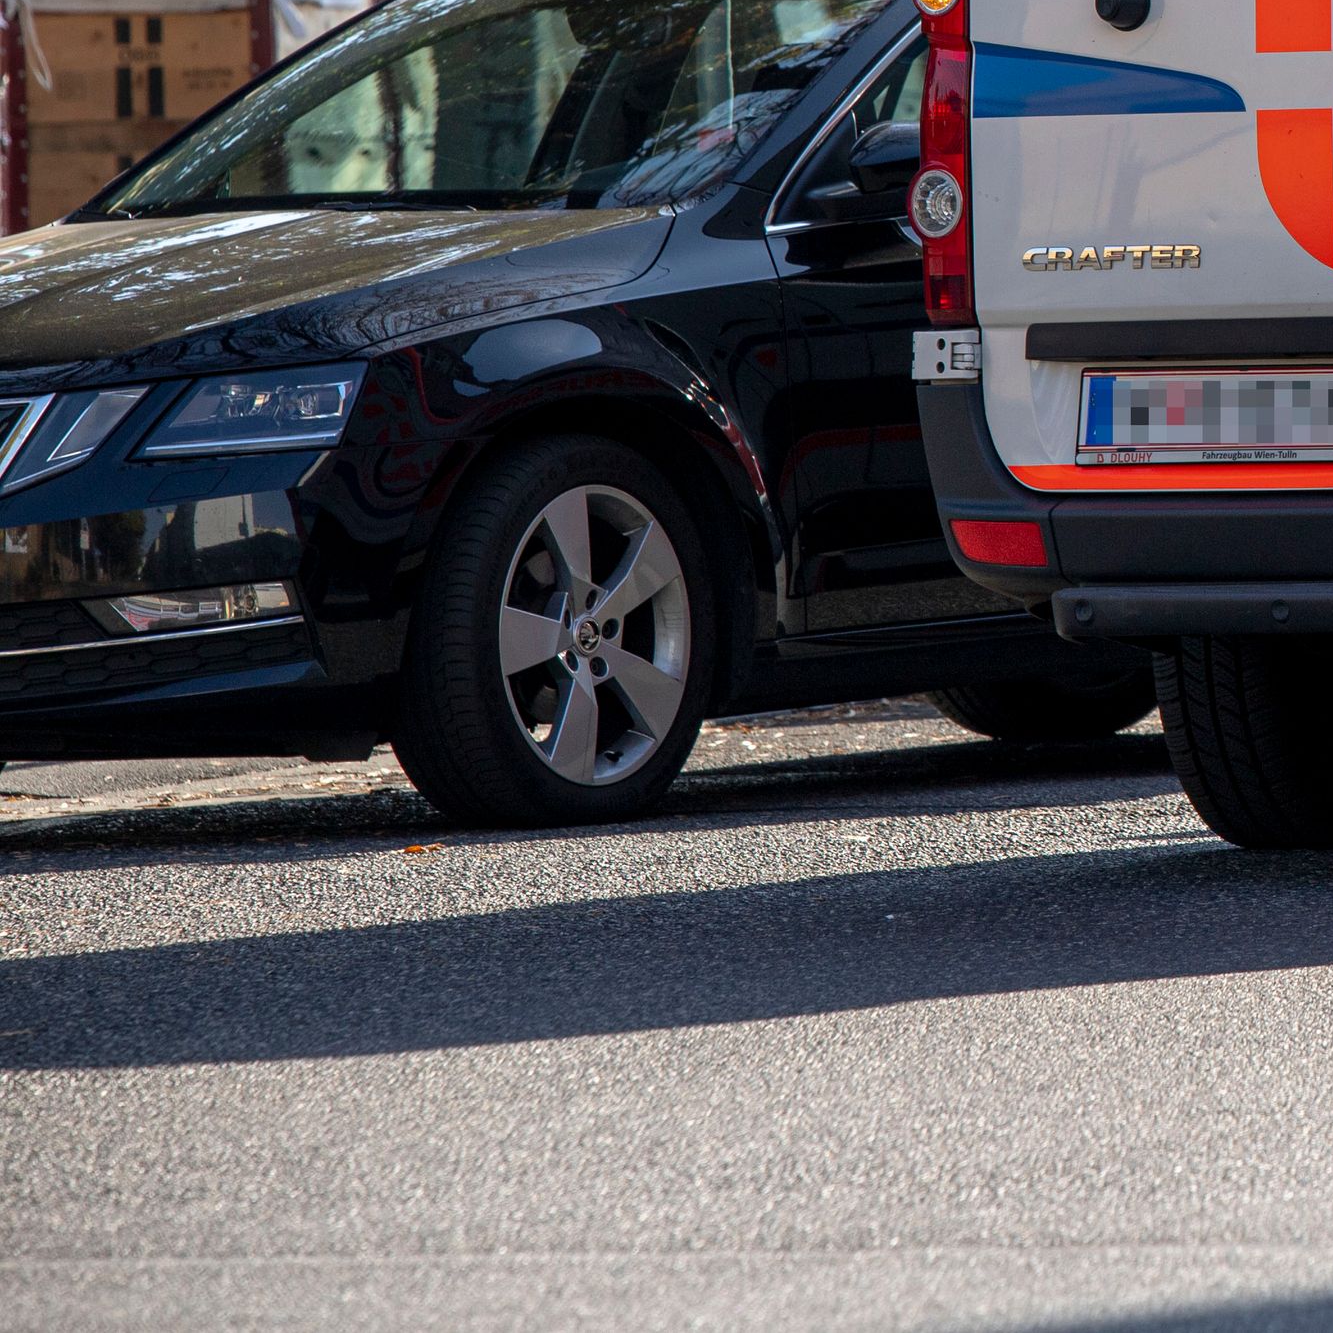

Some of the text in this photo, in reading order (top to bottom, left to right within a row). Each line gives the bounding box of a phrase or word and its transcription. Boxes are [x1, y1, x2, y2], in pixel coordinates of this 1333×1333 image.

[1022, 244, 1201, 272] CRAFTER
[1111, 452, 1153, 464] DLOUHY
[1202, 450, 1298, 462] Fahrzeugbau Wien-Tulln
